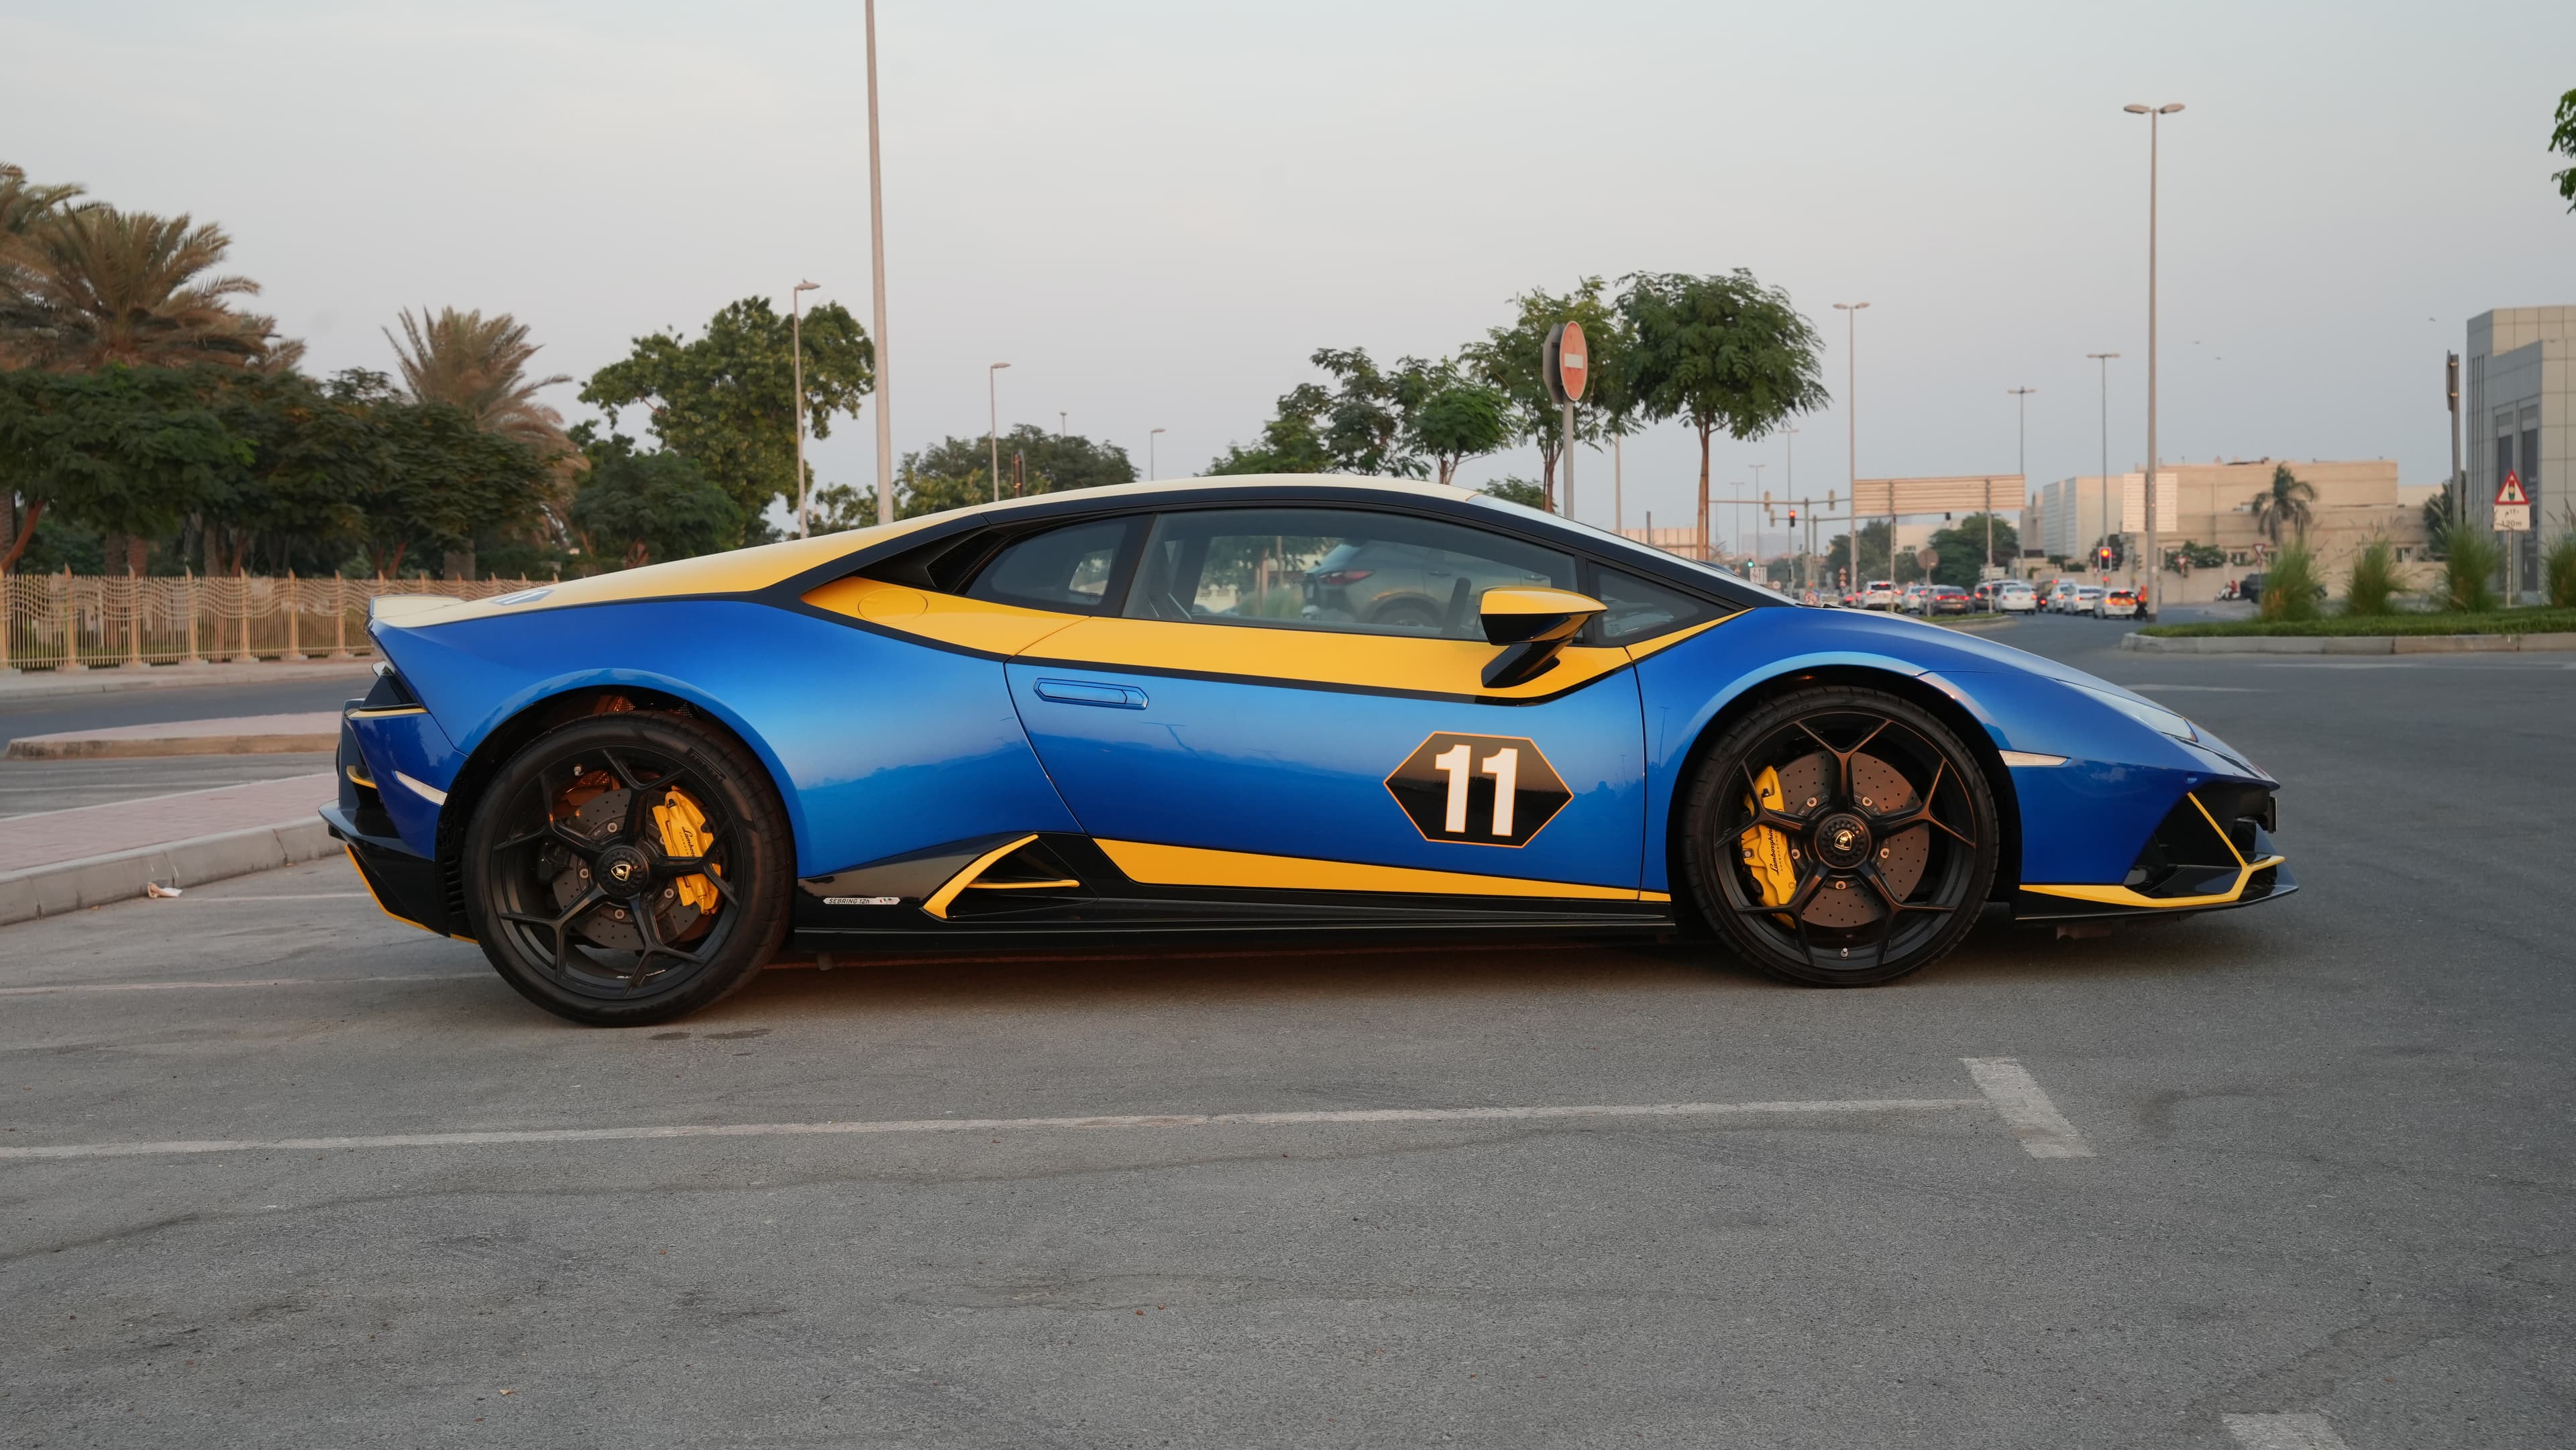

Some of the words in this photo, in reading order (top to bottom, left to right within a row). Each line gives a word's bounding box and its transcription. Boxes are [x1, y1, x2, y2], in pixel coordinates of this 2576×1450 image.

[1435, 744, 1518, 836] 11
[682, 826, 695, 857] Lambor
[1768, 829, 1779, 876] Lamborghin
